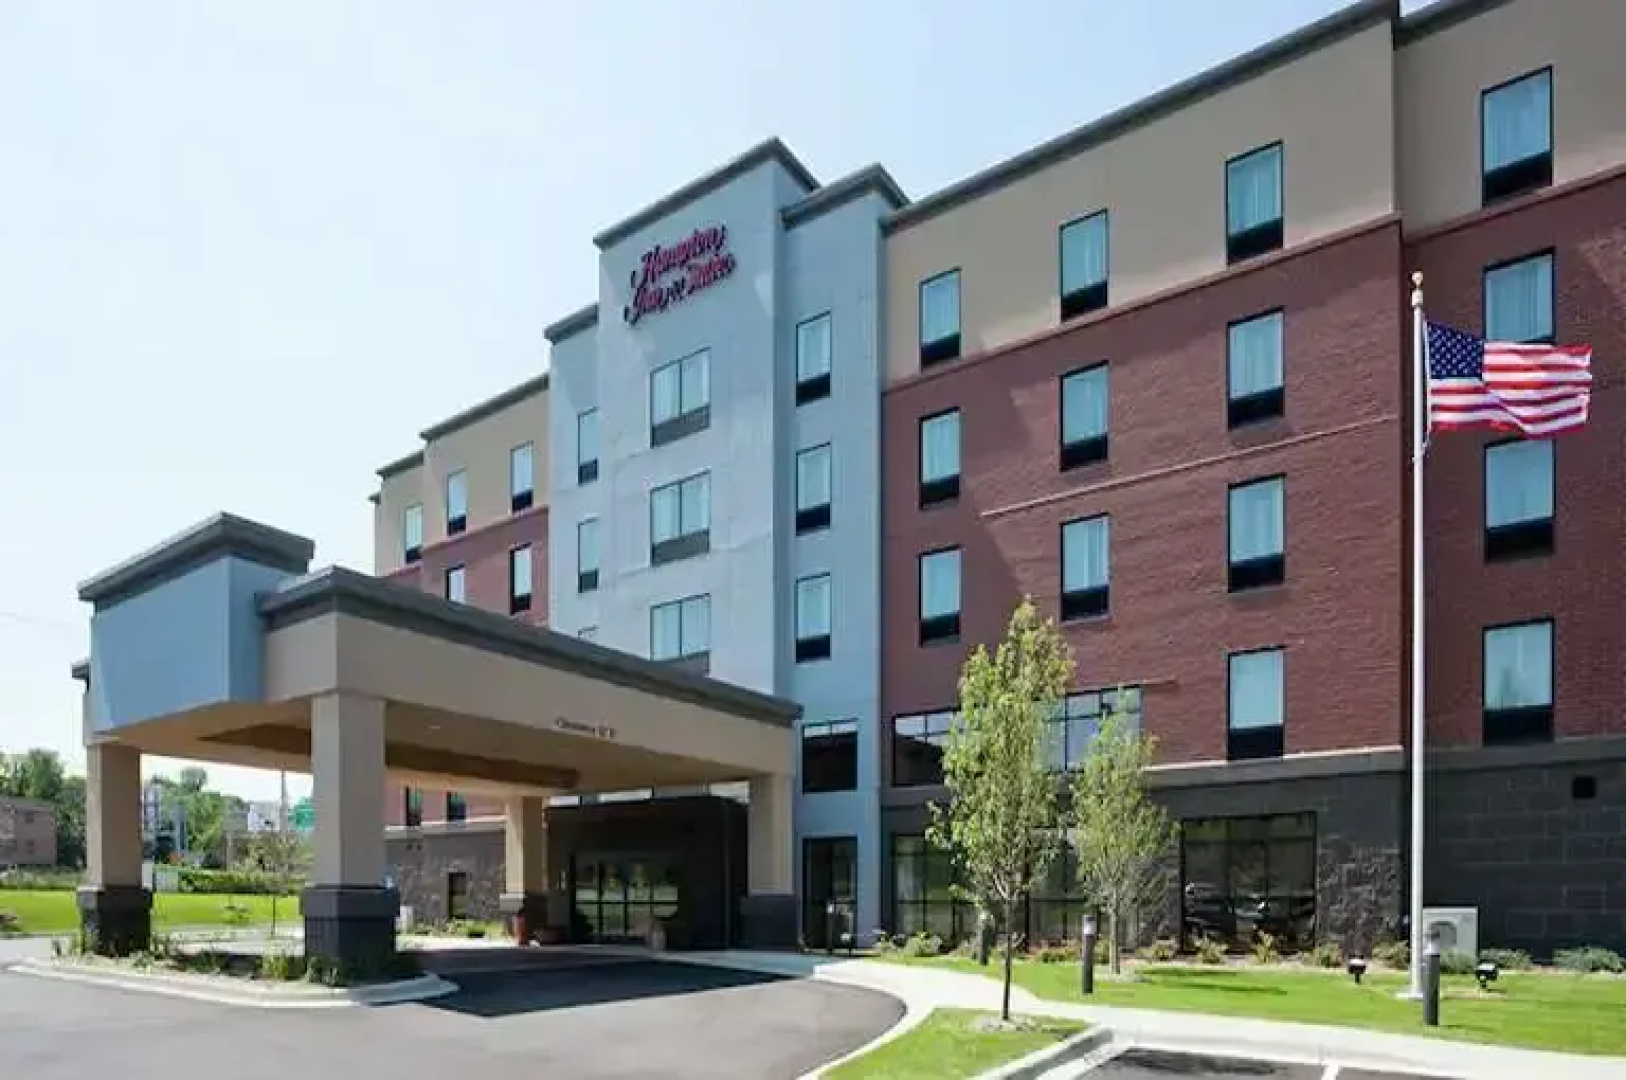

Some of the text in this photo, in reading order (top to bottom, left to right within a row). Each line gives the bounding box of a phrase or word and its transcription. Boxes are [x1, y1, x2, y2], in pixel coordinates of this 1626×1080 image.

[624, 284, 669, 326] Inn
[686, 252, 736, 295] Suites
[630, 224, 727, 304] Hampton
